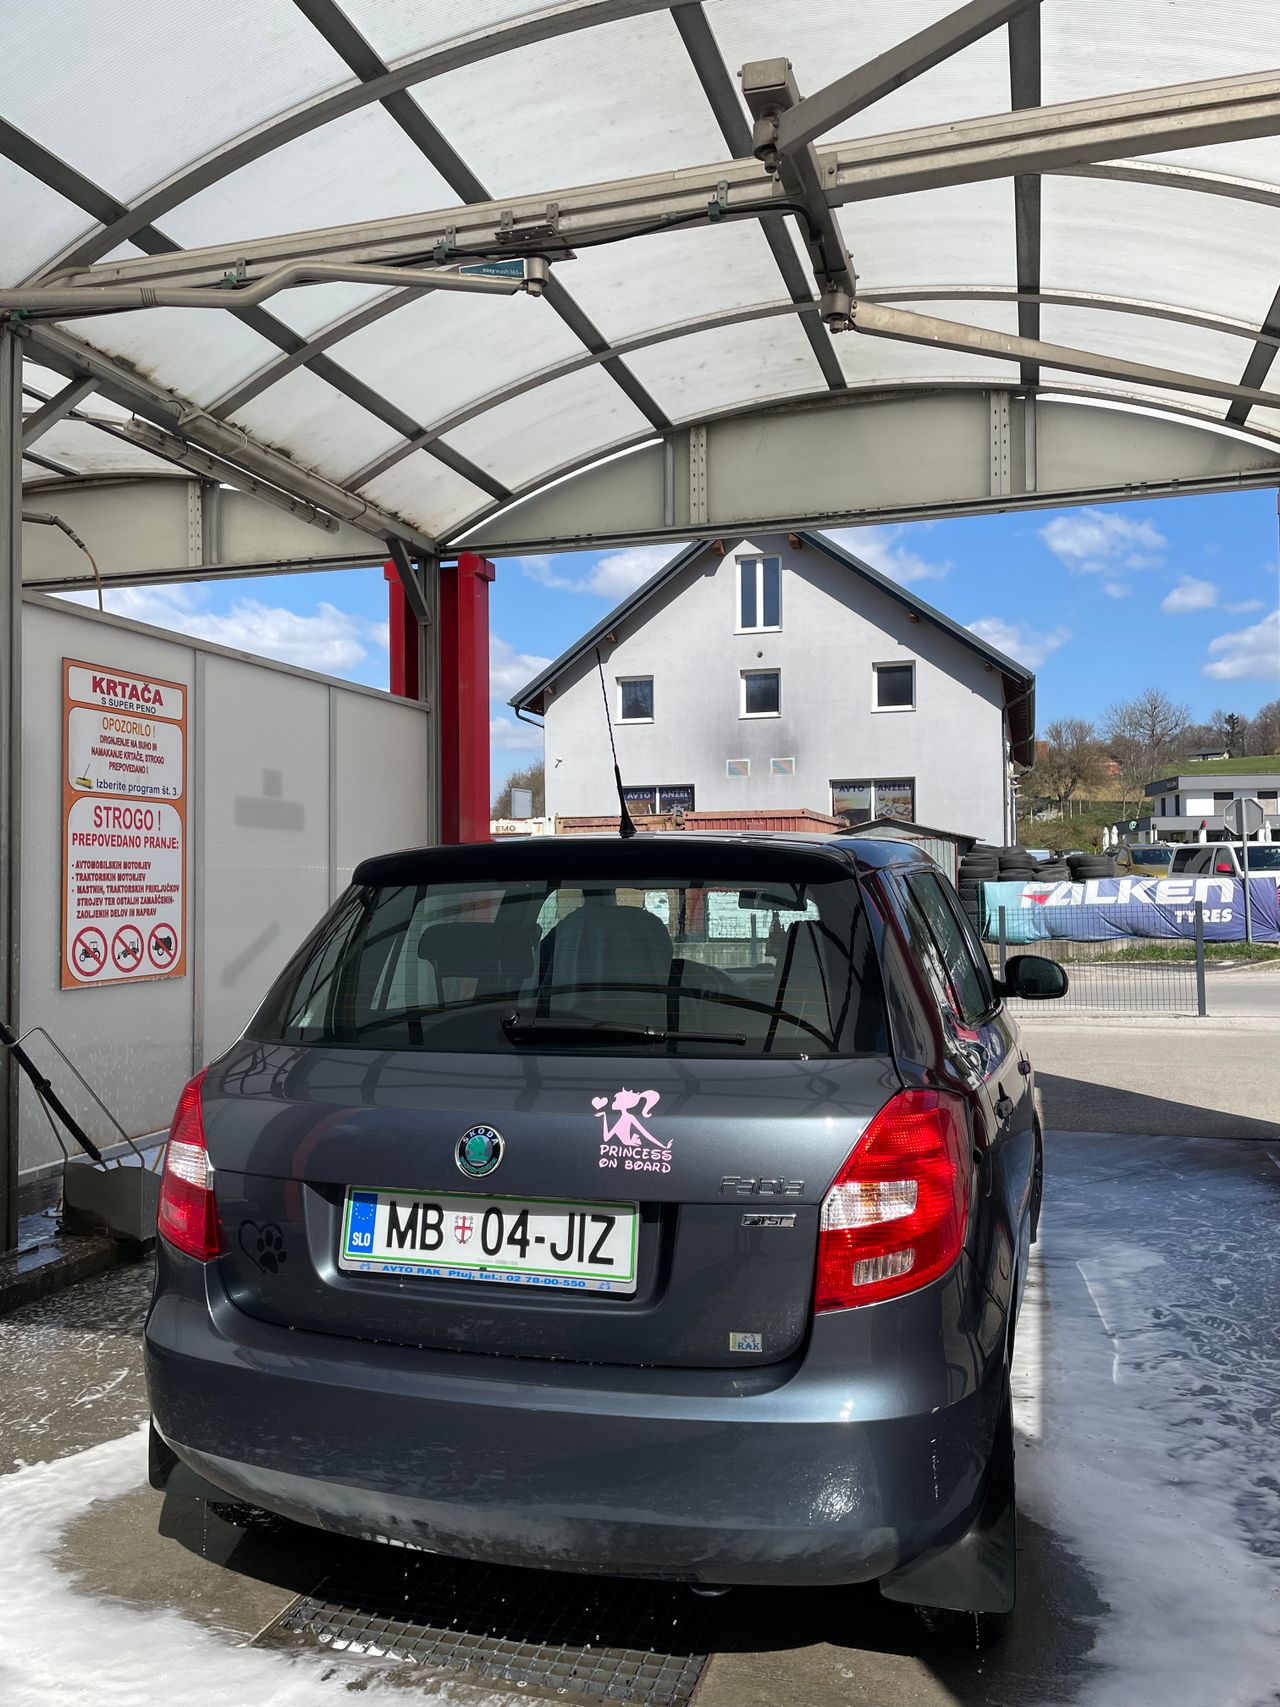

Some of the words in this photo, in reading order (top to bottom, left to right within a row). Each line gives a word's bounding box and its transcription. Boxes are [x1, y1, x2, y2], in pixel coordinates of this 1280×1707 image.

[92, 675, 164, 706] KRTAČA
[101, 697, 107, 705] S
[108, 698, 134, 710] SUPER
[136, 703, 156, 714] PENO
[102, 717, 151, 737] OPOZORILO
[130, 739, 138, 748] NA
[138, 741, 152, 751] SUHO
[91, 746, 123, 760] NAMAKANJE
[145, 753, 165, 765] STROGO
[108, 761, 146, 774] PREPOVEDANO
[96, 779, 126, 791] Izberite
[128, 783, 160, 795] program
[161, 785, 171, 795] št.
[839, 784, 865, 793] AVTO
[627, 791, 651, 800] AVTO
[93, 805, 154, 831] STROGO
[72, 832, 141, 848] PREPOVEDANO
[143, 836, 179, 850] PRANJE:
[75, 860, 122, 870] AVTOMOBILSKIH
[123, 861, 152, 870] MOTORJEV
[75, 873, 117, 881] TRAKTORSKIH
[117, 872, 146, 881] MOTORJEV
[106, 884, 145, 894] TRAKTORSKIH
[1018, 878, 1235, 908] FALKEN
[76, 897, 104, 907] STROJEV
[104, 896, 116, 906] TER
[116, 896, 140, 906] OSTALIH
[110, 908, 128, 918] DELOV
[1174, 908, 1233, 924] TYRES
[599, 1144, 672, 1161] PRINCESS
[598, 1157, 618, 1169] ON
[624, 1159, 671, 1174] BOARD
[352, 1232, 371, 1247] SLO
[386, 1201, 444, 1251] MB
[481, 1206, 616, 1266] 04-JIZ
[382, 1264, 414, 1274] AVTO
[416, 1266, 441, 1275] RAK
[447, 1269, 476, 1280] Ptuj,
[479, 1272, 503, 1281] tel.:
[506, 1275, 521, 1283] 02
[526, 1276, 586, 1288] 78-00-550
[737, 1341, 760, 1350] RAK
